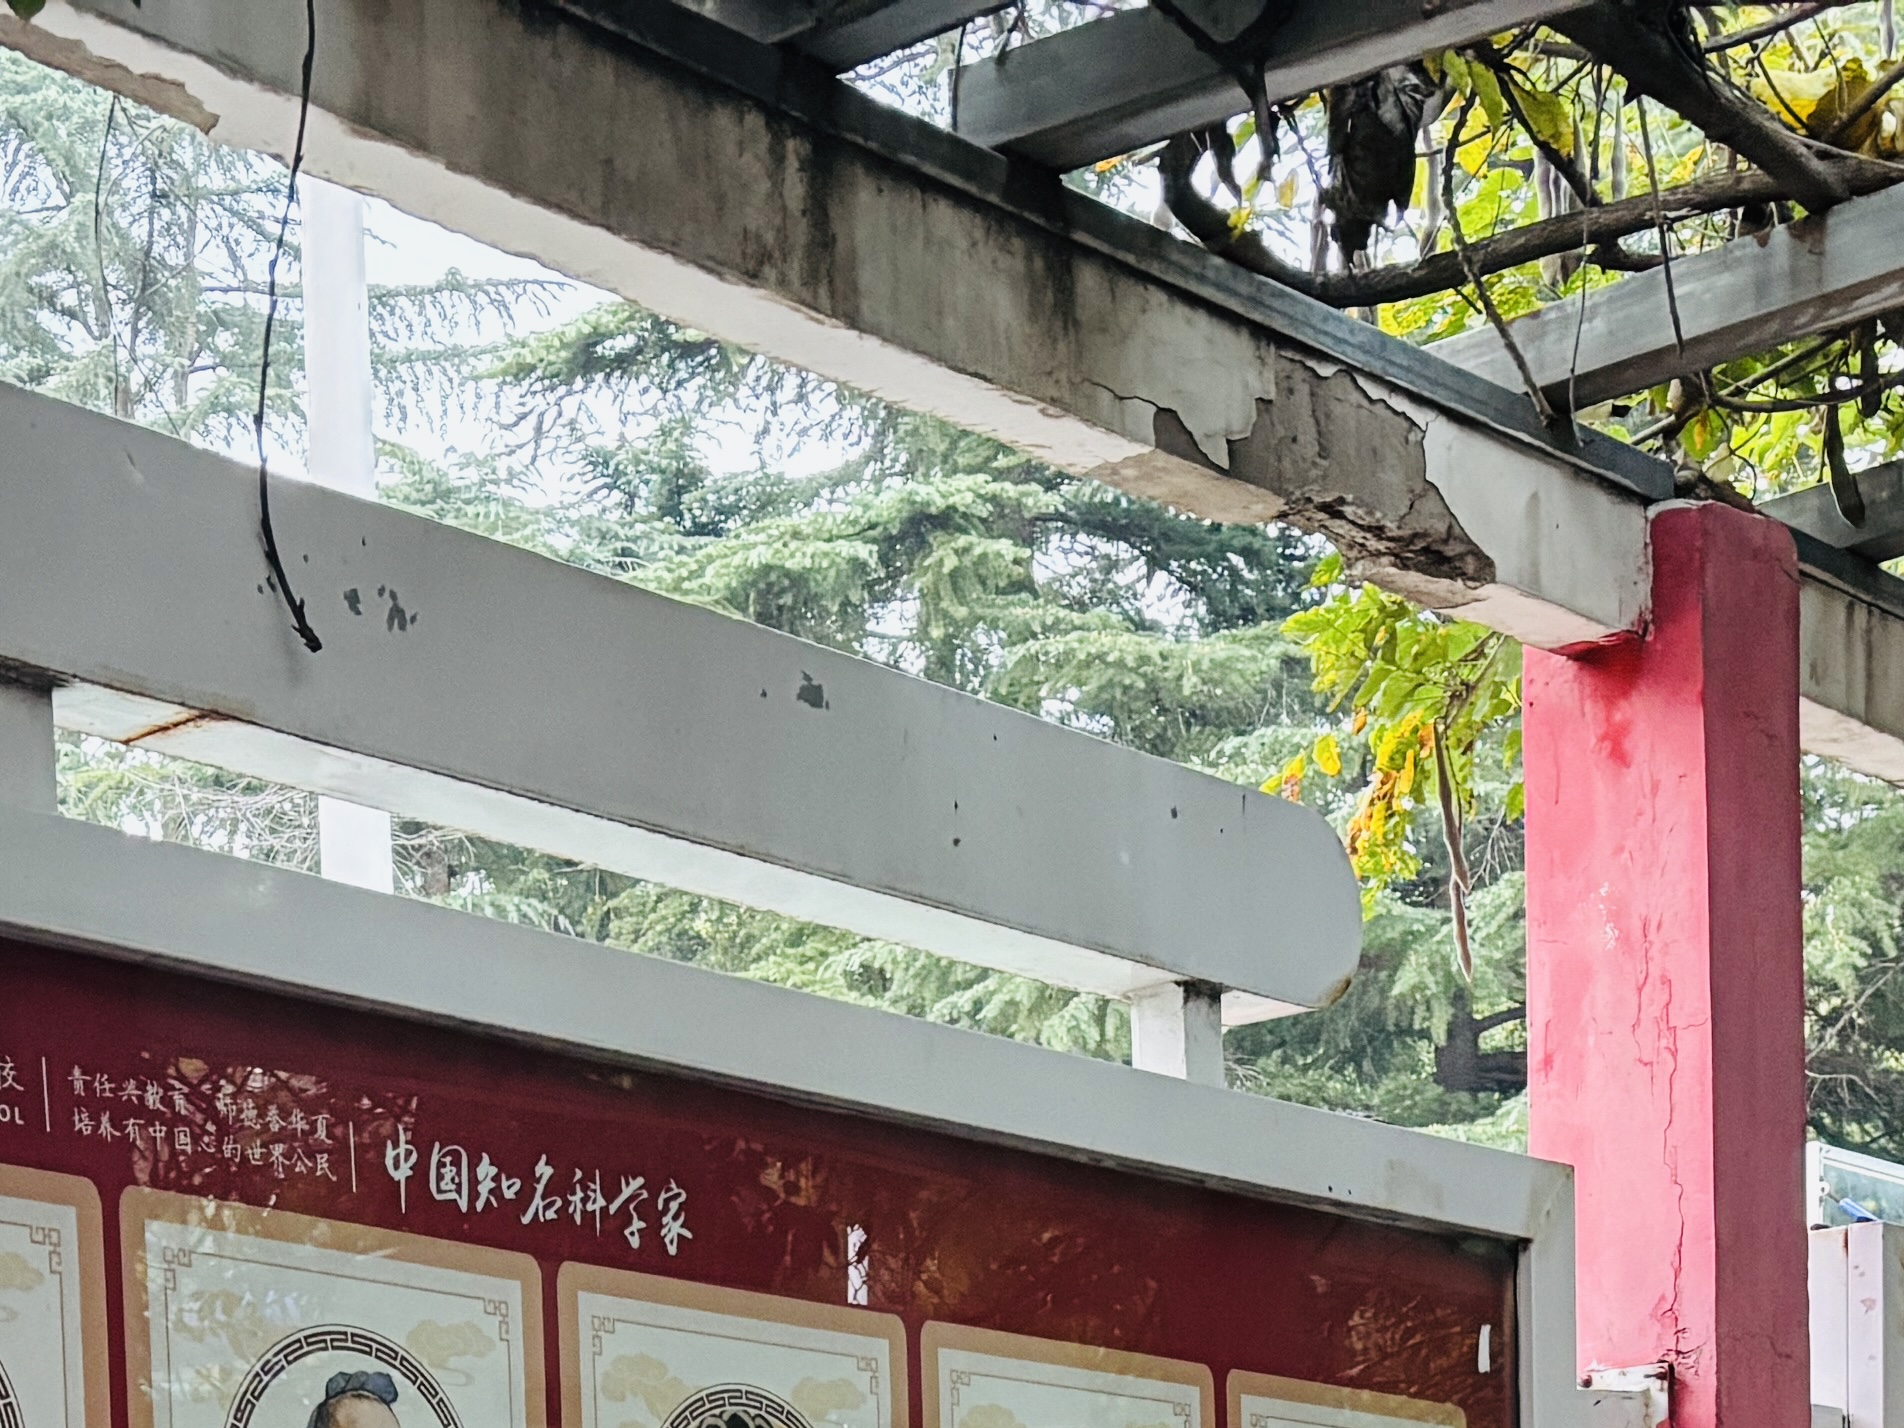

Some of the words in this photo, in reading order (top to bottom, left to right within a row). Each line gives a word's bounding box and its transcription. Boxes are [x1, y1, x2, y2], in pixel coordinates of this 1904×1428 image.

[384, 1124, 693, 1256] 中国知名科学家
